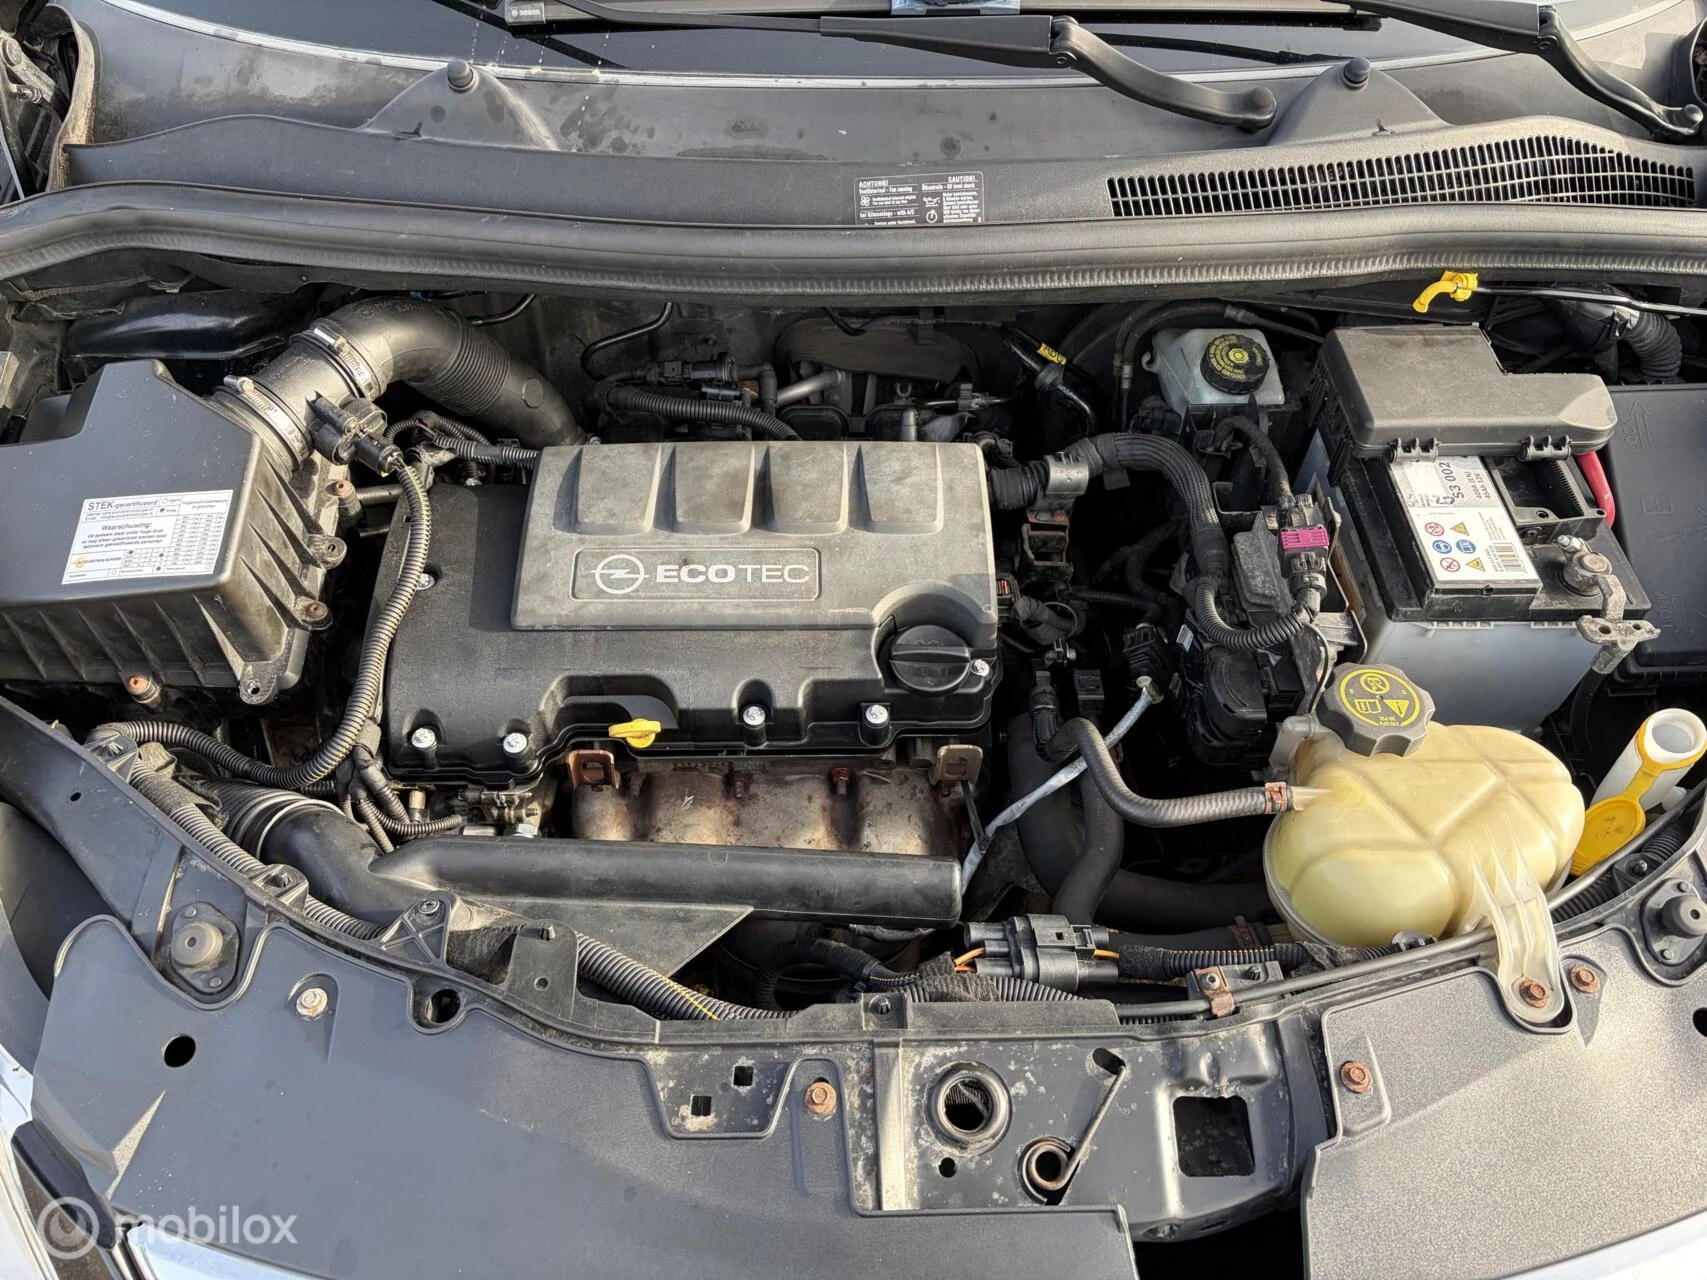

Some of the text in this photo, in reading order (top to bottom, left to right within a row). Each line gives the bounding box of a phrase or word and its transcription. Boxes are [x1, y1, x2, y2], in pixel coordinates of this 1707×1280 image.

[859, 180, 888, 189] ACHTUNG!
[948, 175, 975, 183] CAUTION!
[1438, 462, 1456, 482] 002
[656, 564, 810, 583] ECOTEC
